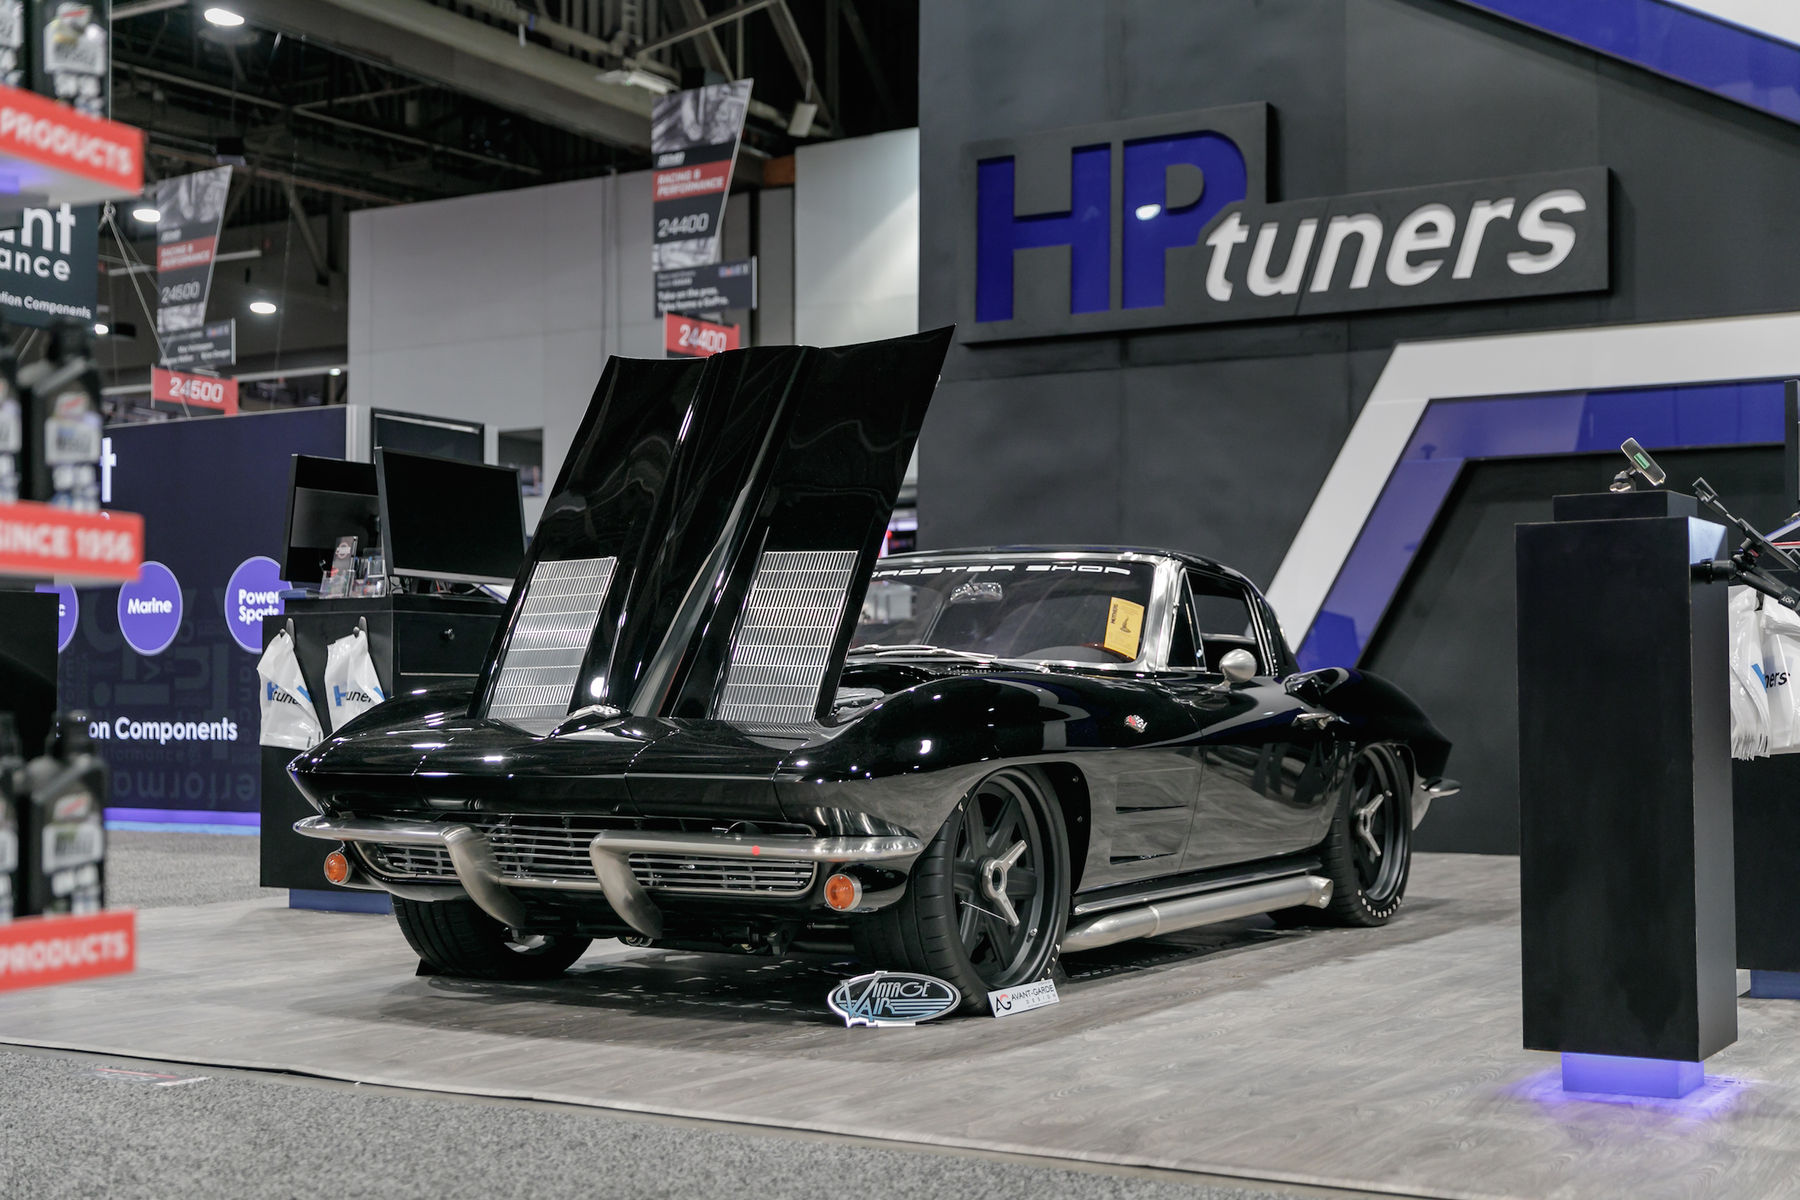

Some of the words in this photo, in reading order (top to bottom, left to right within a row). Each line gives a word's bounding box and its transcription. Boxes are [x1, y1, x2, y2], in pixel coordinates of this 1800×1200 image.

[0, 107, 133, 176] PRODUCTS
[657, 213, 710, 239] 24400
[975, 129, 1247, 323] HP
[1205, 188, 1587, 302] tuners
[161, 281, 200, 304] 24500
[24, 295, 92, 320] Components
[678, 324, 728, 352] 24400
[169, 376, 225, 403] 24500
[74, 525, 135, 563] 1956
[1025, 564, 1132, 576] SHOP
[127, 597, 173, 615] Marine
[114, 716, 239, 745] Components
[0, 931, 129, 976] PRODUCTS
[840, 972, 932, 1020] VINTAGE
[1011, 984, 1055, 1001] AVANT-GARDE
[856, 998, 896, 1022] AIR
